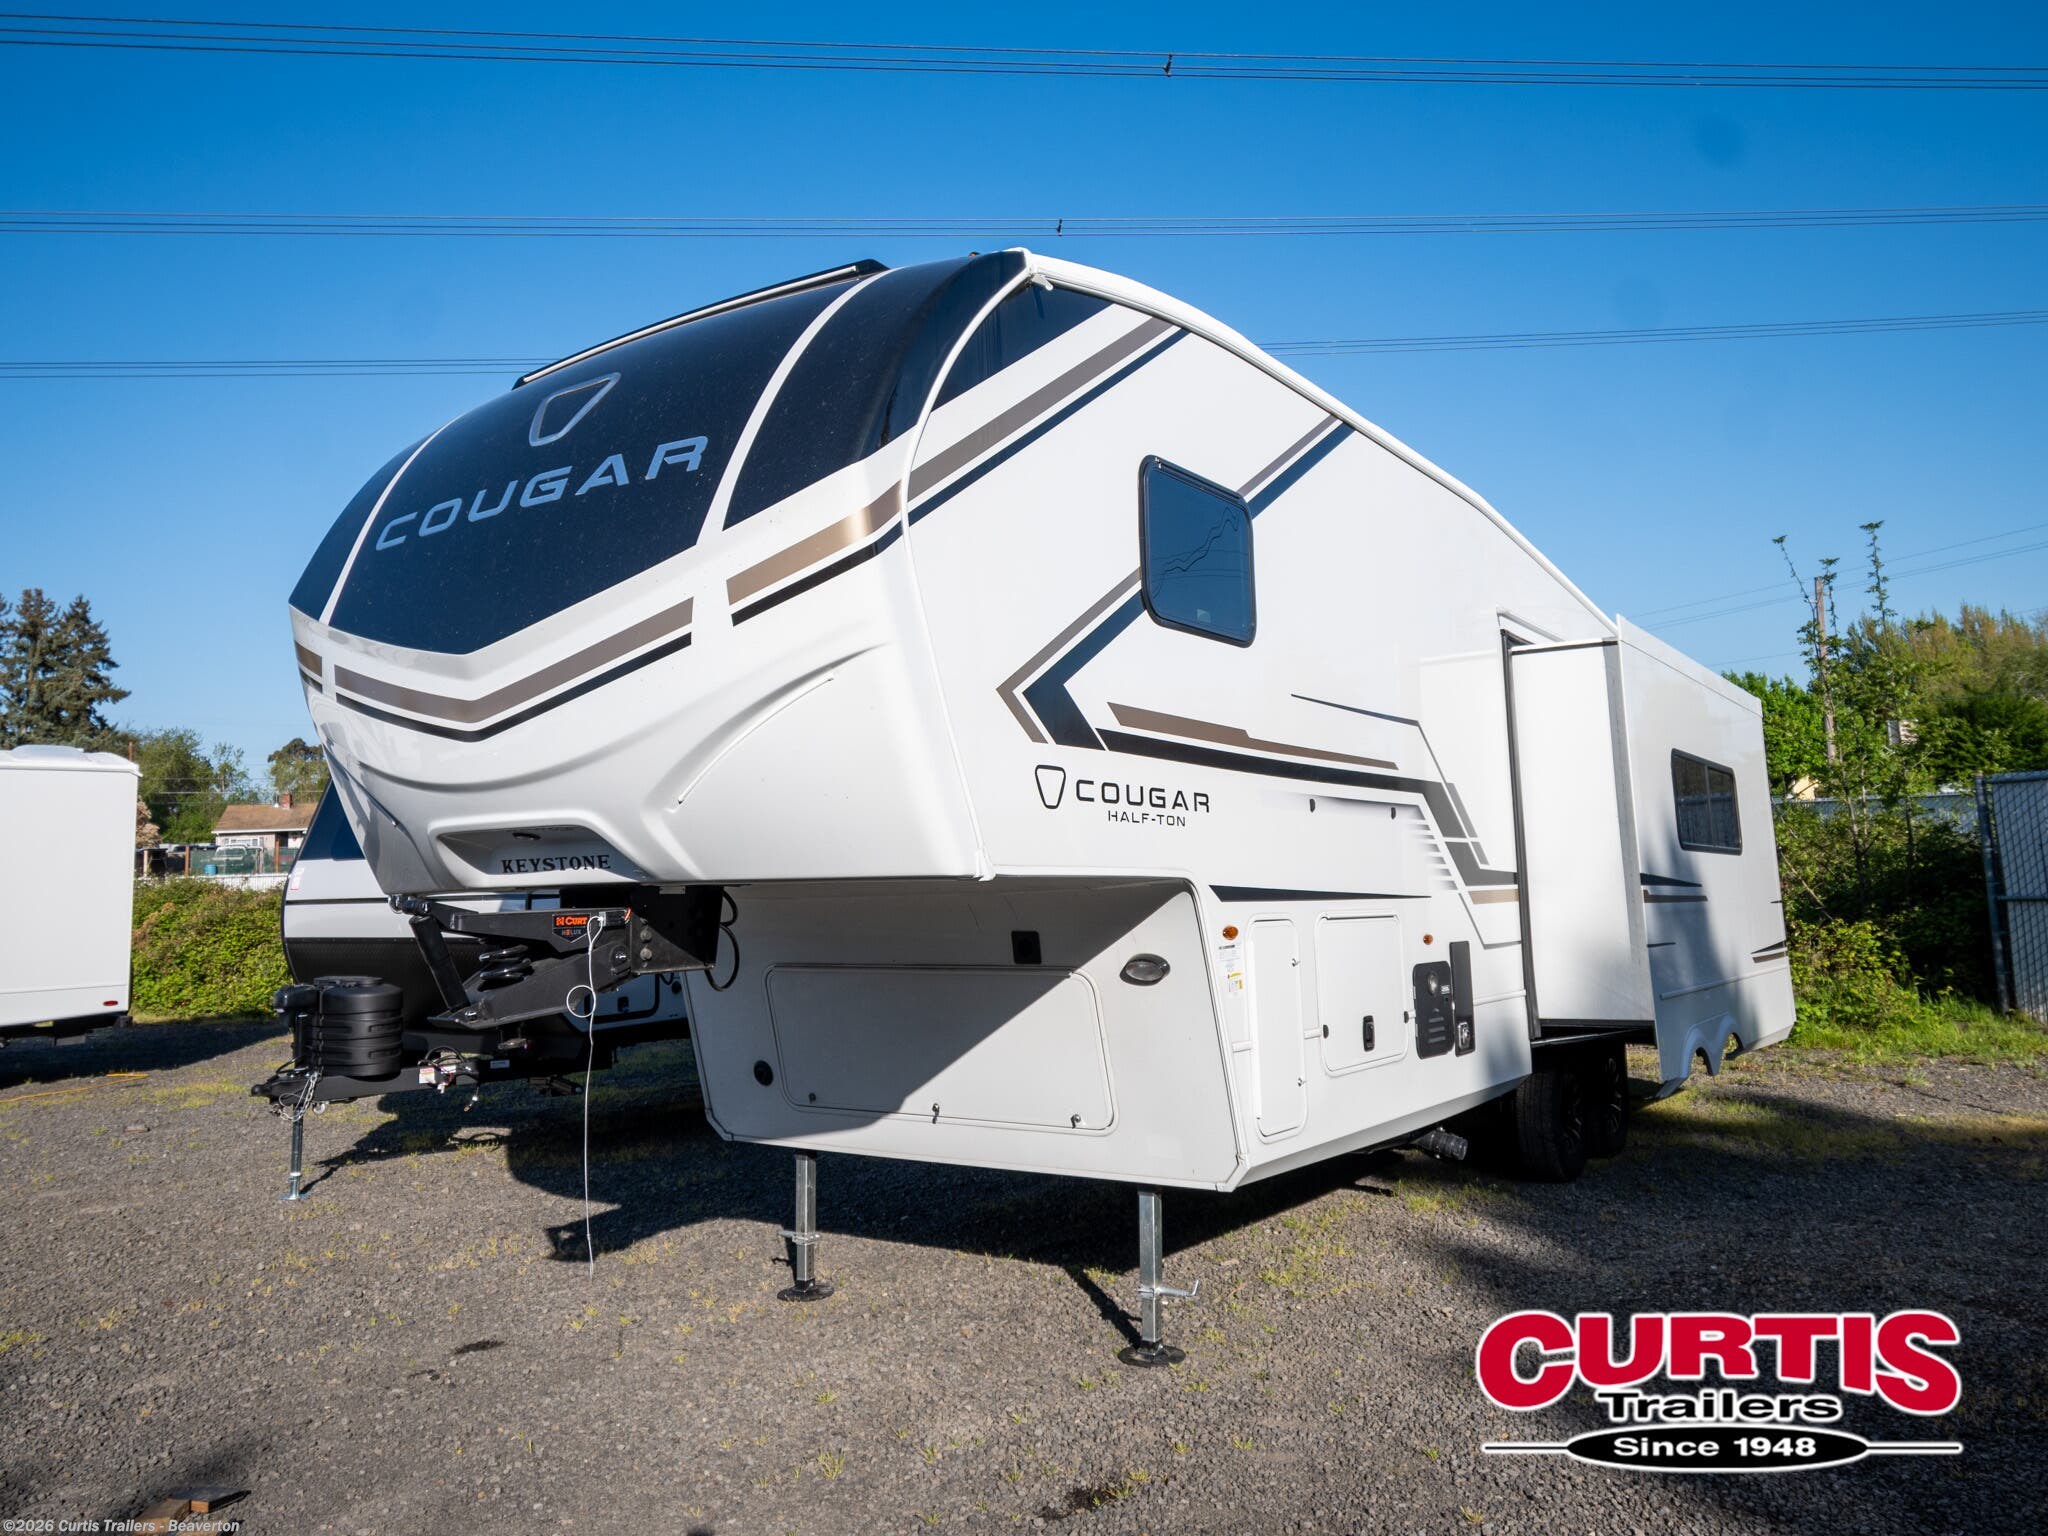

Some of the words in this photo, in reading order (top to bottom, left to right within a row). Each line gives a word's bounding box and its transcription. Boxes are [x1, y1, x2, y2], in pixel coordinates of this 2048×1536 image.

[375, 436, 709, 551] COUGAR
[1076, 779, 1210, 813] COUGAR
[1108, 810, 1186, 827] HALF-TON
[501, 854, 611, 873] KEYSTONE
